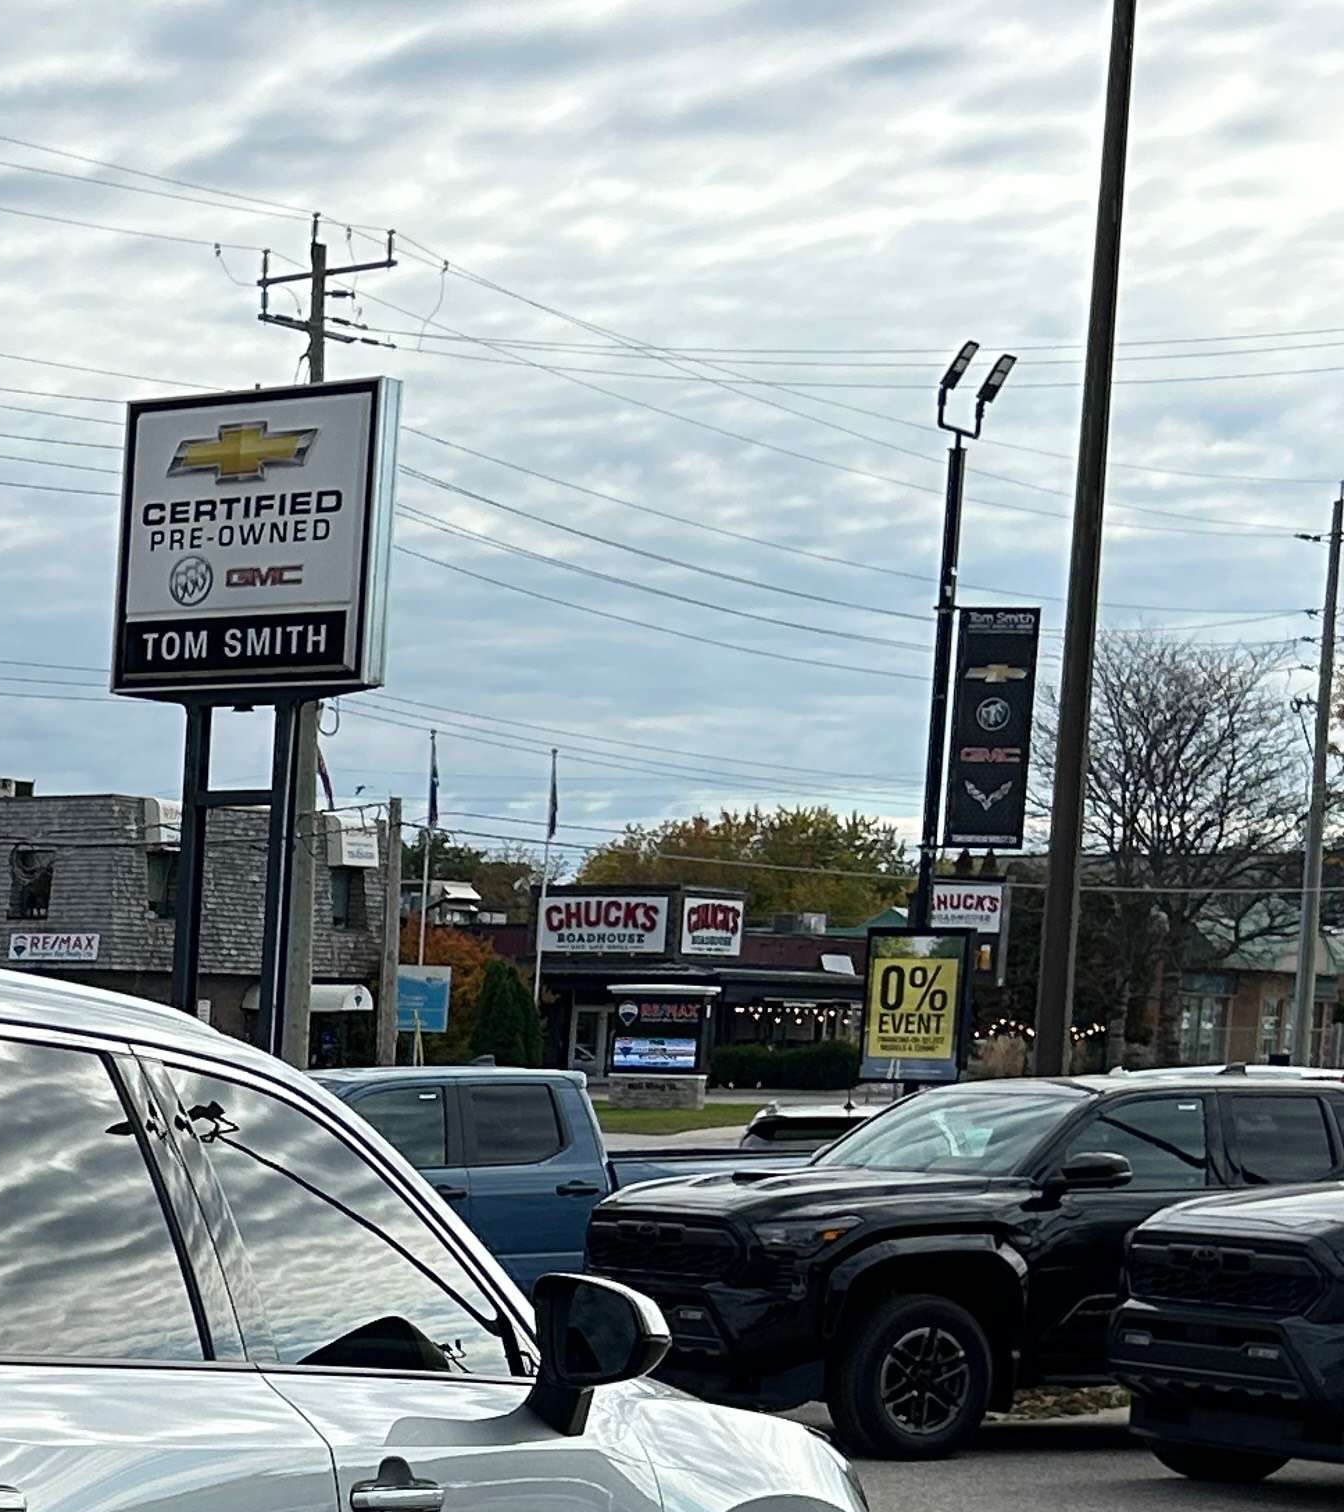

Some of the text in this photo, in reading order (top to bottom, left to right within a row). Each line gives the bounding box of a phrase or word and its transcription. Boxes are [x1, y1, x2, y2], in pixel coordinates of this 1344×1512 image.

[142, 490, 343, 526] CERTIFIED
[150, 518, 330, 552] PRE-OWNED
[225, 564, 304, 588] GMC
[969, 611, 1035, 624] Tom Smith
[142, 624, 327, 661] TOM SMITH
[960, 747, 1022, 763] GMC
[932, 893, 999, 913] HUCK'S
[545, 900, 660, 932] CHUCK'S
[30, 935, 95, 950] RE/MAX
[557, 933, 645, 943] ROADHOUSE
[880, 964, 947, 1011] 0%
[878, 1013, 945, 1034] EVENT
